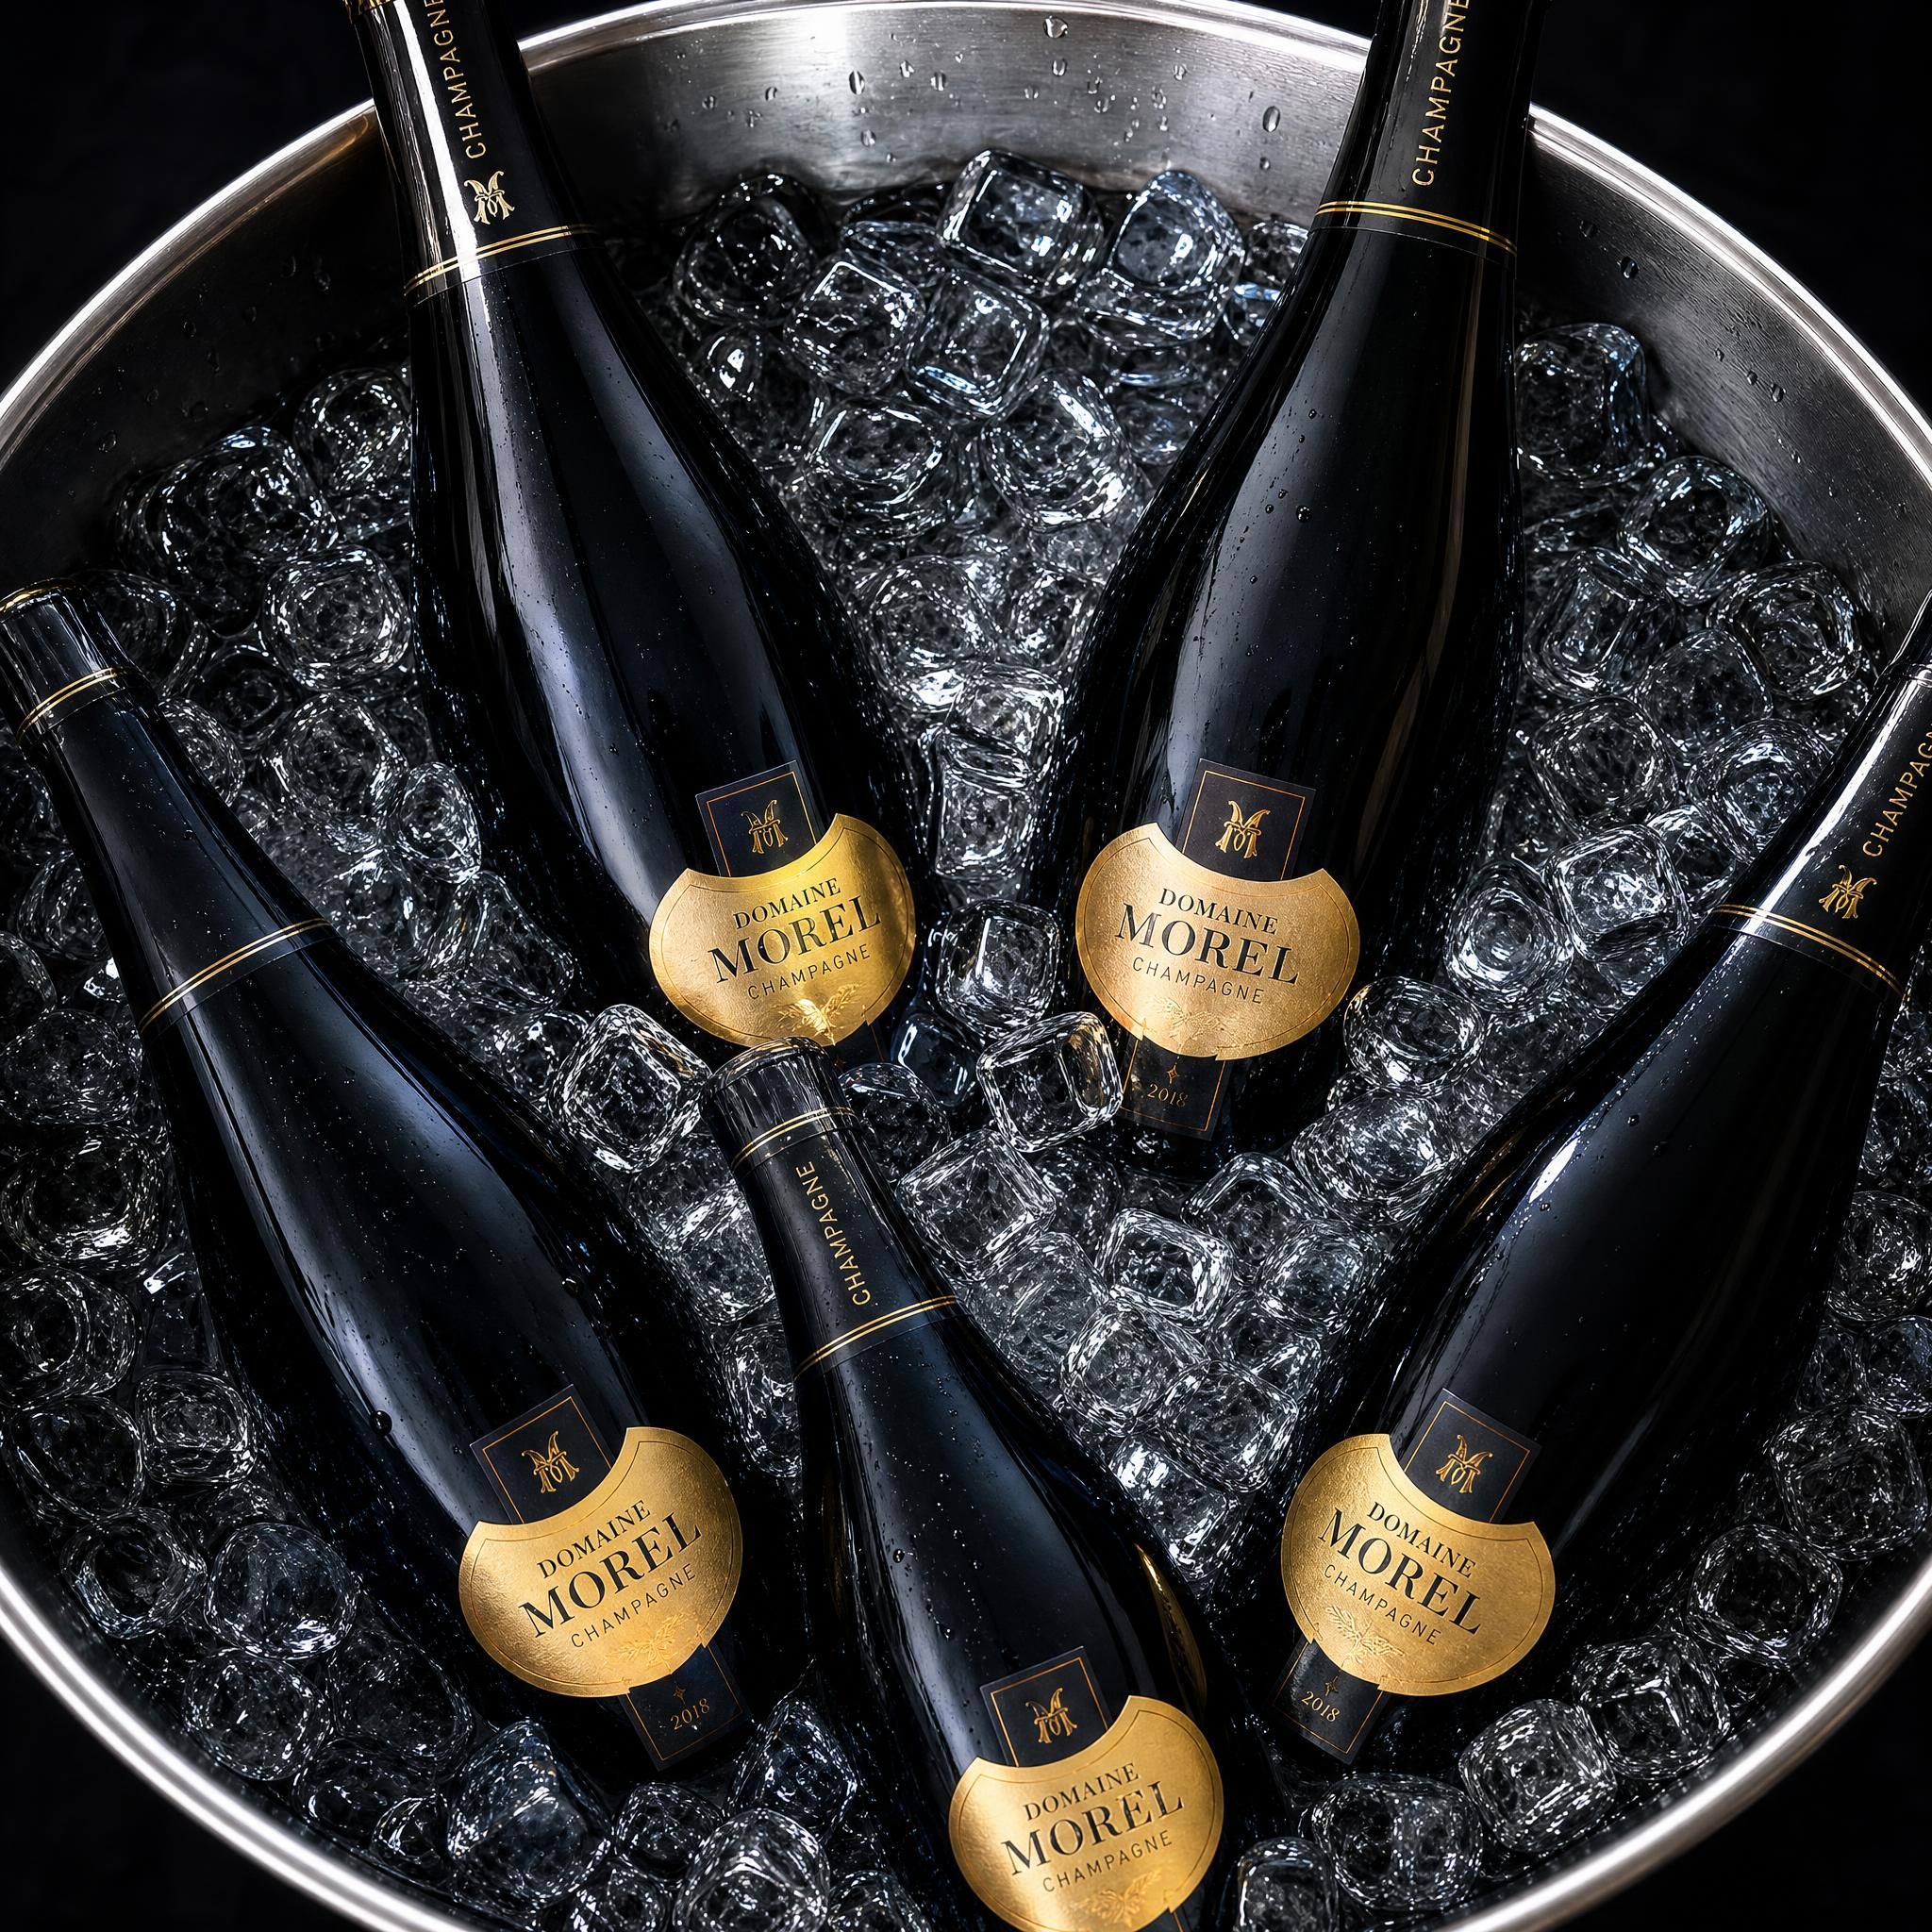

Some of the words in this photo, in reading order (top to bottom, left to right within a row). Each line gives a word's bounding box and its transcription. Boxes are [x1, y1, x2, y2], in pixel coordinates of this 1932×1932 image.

[1862, 724, 1932, 858] CHAMPAG
[708, 895, 881, 984] MOREL
[732, 877, 841, 930] DOMAINE
[1158, 888, 1279, 936] DOMAINE
[747, 943, 871, 1000] CHAMPAGNE
[1114, 902, 1300, 987] MOREL
[1132, 957, 1265, 1005] CHAMPAGNE
[1147, 1083, 1189, 1108] 2018
[795, 1160, 873, 1307] CHAMPAGNE
[518, 1511, 702, 1639] MOREL
[536, 1499, 651, 1579] DOMAINE
[1317, 1507, 1482, 1635] MOREL
[1367, 1502, 1476, 1578] DOMAINE
[570, 1562, 696, 1649] CHAMPAGNE
[1324, 1564, 1442, 1645] CHAMPAGNE
[670, 1698, 710, 1730] 2018
[1301, 1690, 1341, 1723] 2018
[1001, 1780, 1185, 1876] MOREL
[1024, 1762, 1141, 1822] DOMAINE
[1041, 1829, 1174, 1892] CHAMPAGNE
